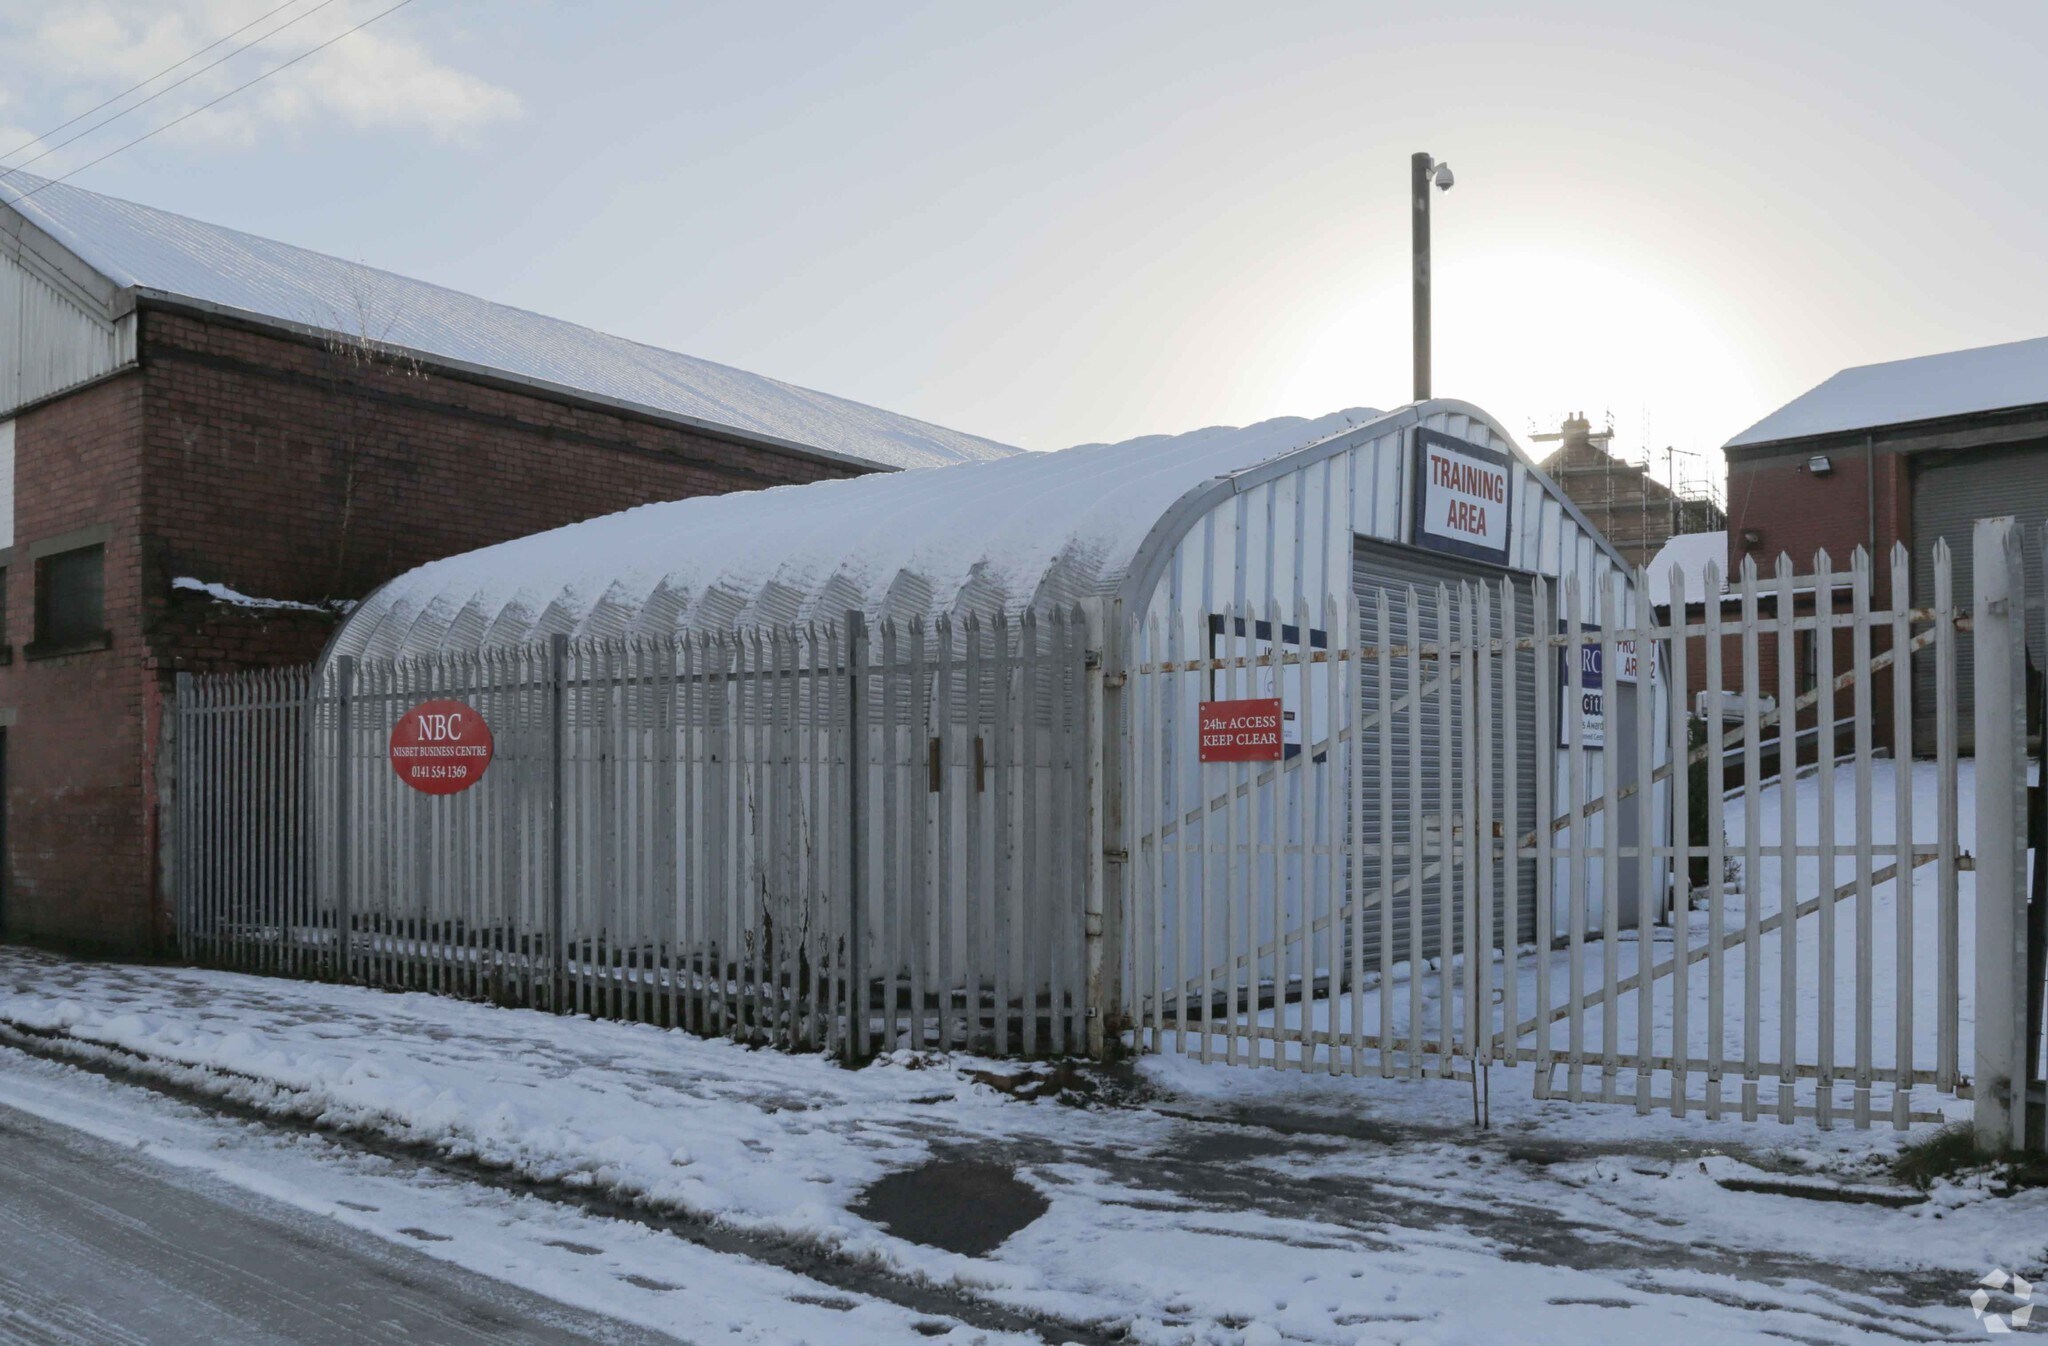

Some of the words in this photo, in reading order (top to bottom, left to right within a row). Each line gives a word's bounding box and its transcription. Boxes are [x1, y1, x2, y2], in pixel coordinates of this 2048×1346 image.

[1431, 455, 1504, 504] TRAINING
[1447, 499, 1487, 537] AREA
[1616, 641, 1656, 658] PROT
[418, 713, 462, 741] NBC
[1203, 718, 1228, 730] 24hr
[1229, 715, 1276, 729] ACCESS
[1203, 735, 1234, 746] KEEP
[1236, 733, 1278, 745] CLEAR
[393, 746, 419, 757] NISBET
[420, 746, 455, 757] BUSINESS
[455, 746, 487, 757] CENTRE
[411, 766, 430, 778] 0141
[431, 766, 446, 778] 554
[447, 766, 467, 778] 1369
